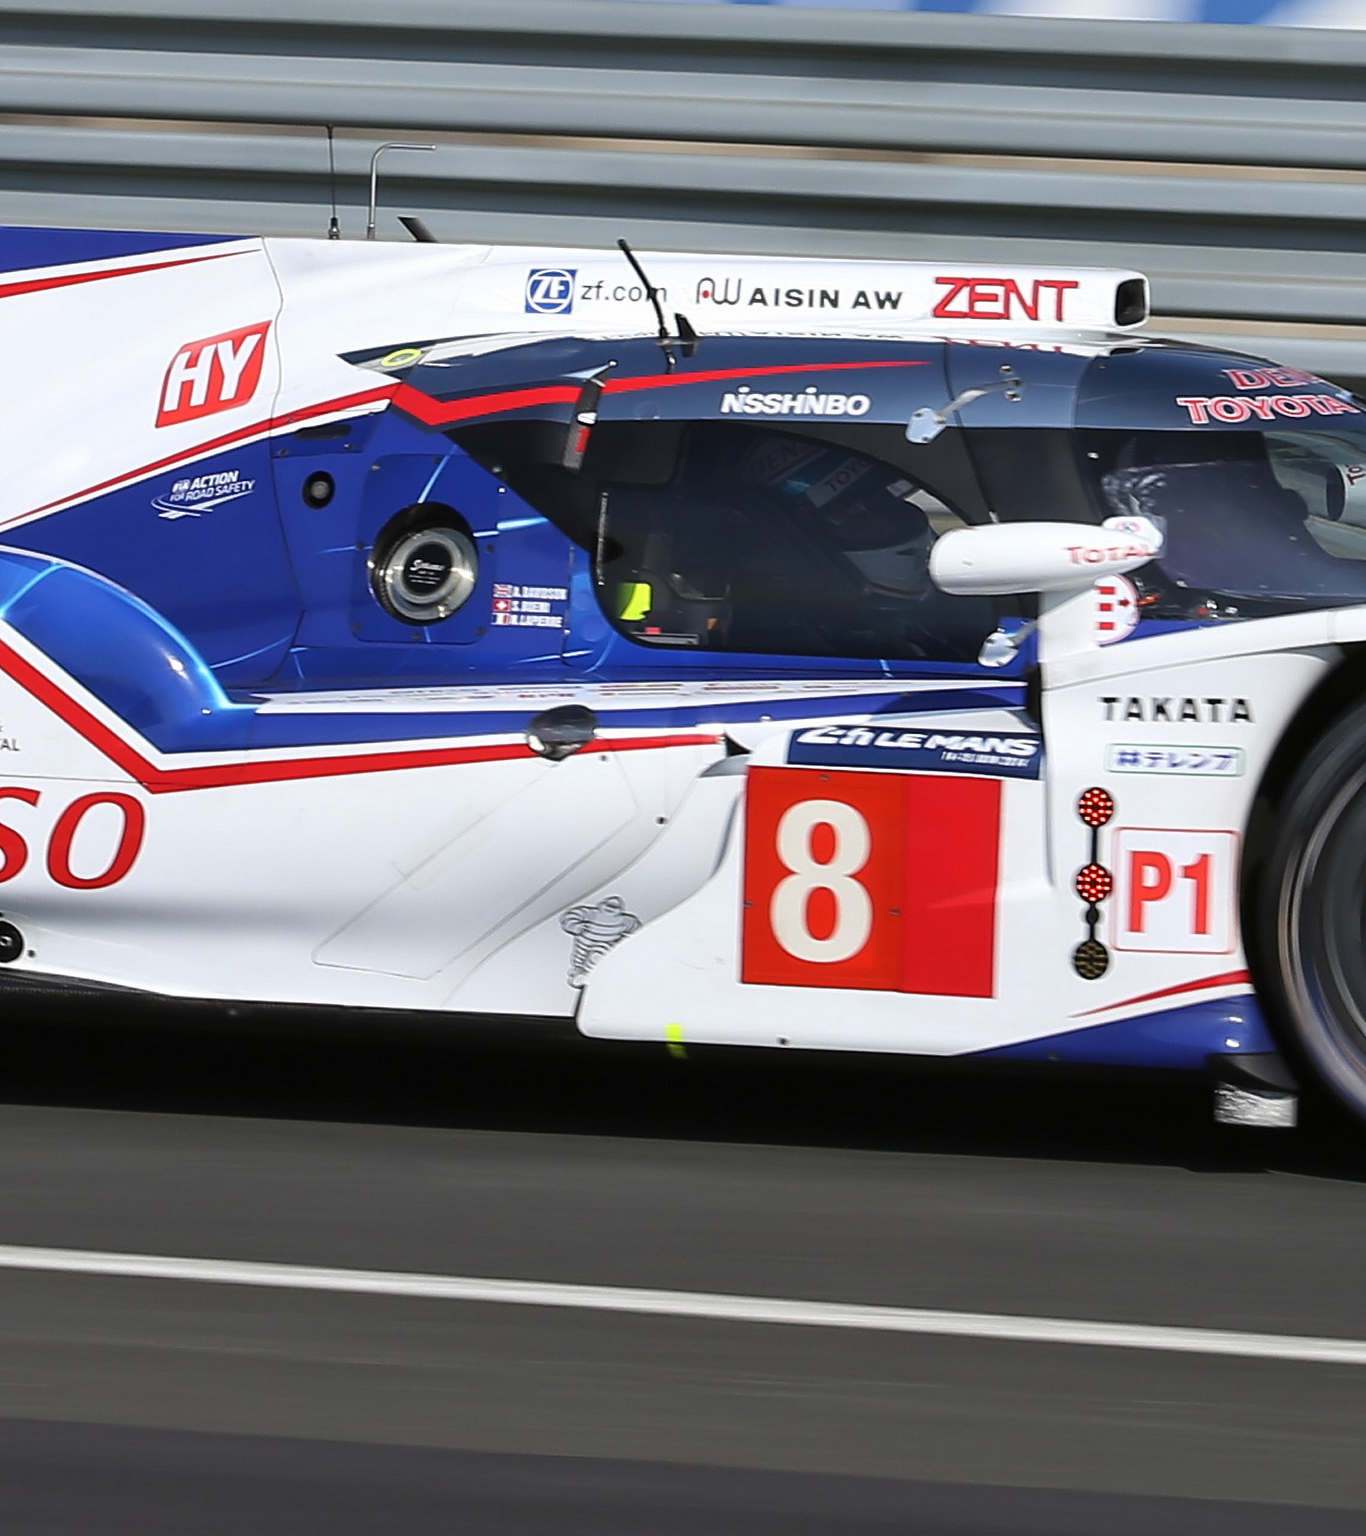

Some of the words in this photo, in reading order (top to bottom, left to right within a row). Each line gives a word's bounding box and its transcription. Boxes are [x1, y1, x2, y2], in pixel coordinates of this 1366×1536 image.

[748, 288, 839, 309] AISIN
[852, 290, 903, 311] AW
[933, 276, 1079, 321] ZENT
[163, 334, 262, 412] HY
[1176, 394, 1362, 424] TOYOTA
[185, 487, 214, 501] ROAD
[215, 480, 256, 496] SAFETY
[190, 470, 239, 490] ACTION
[1098, 696, 1256, 724] TAKATA
[873, 732, 928, 749] LE
[924, 735, 1040, 757] MANS
[770, 800, 873, 963] 8
[1128, 850, 1212, 936] P1
